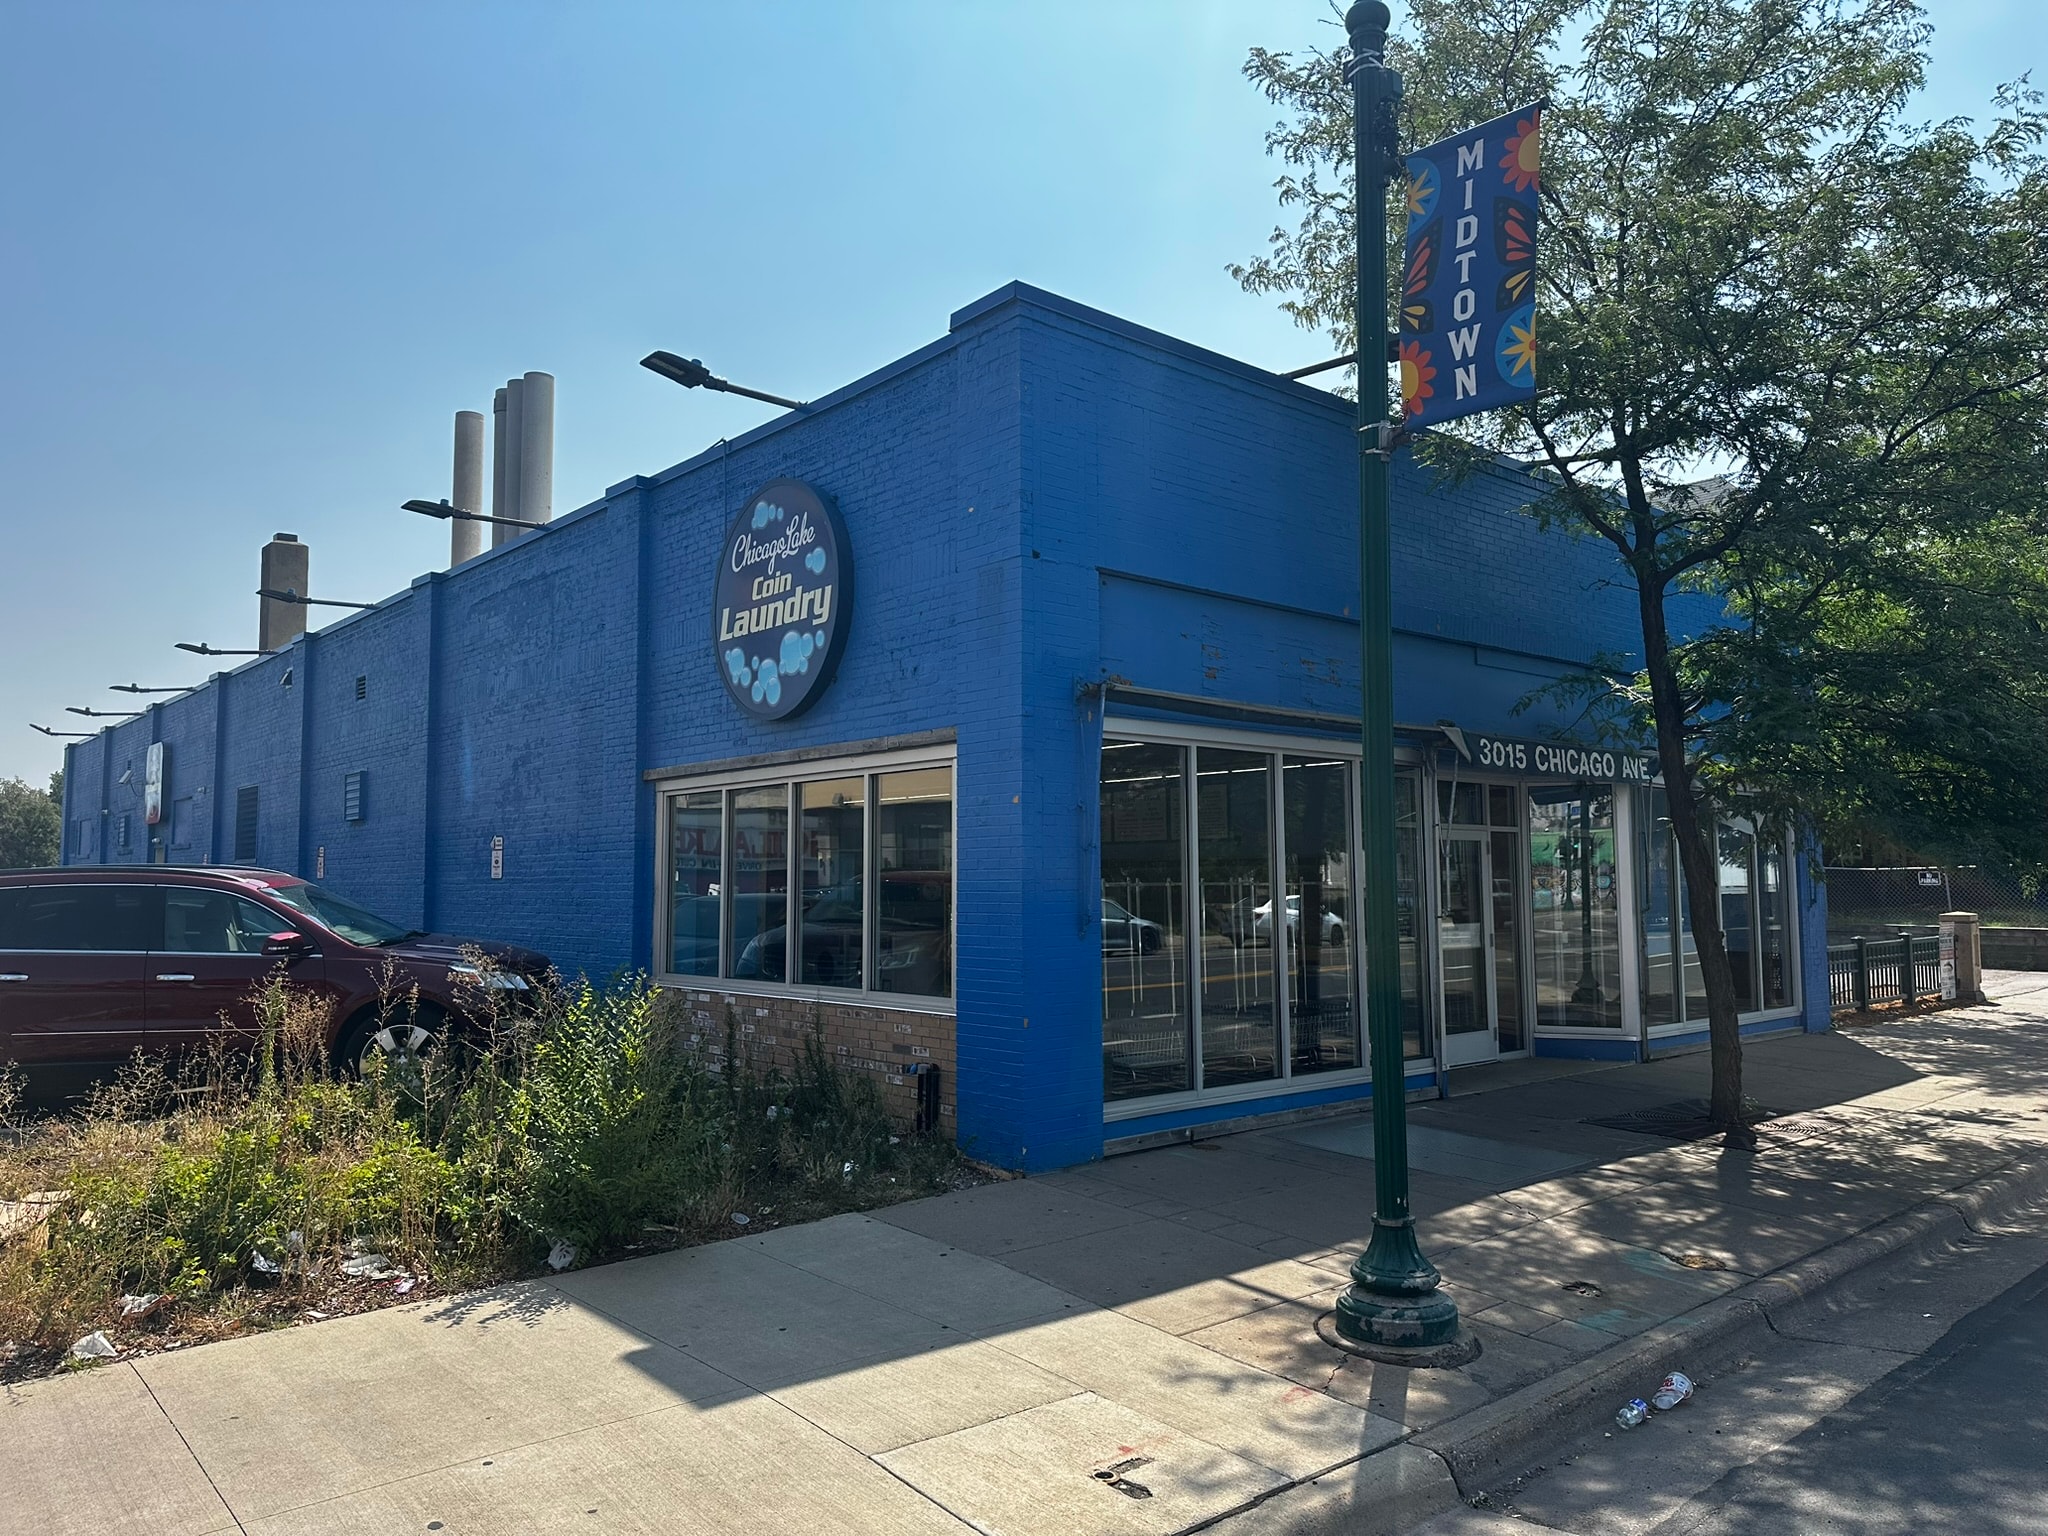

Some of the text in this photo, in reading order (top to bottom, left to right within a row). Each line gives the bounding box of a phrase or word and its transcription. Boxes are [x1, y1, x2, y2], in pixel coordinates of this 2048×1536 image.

[1447, 138, 1485, 401] MIDTOWN
[731, 511, 816, 575] Chicago Lake
[719, 584, 833, 642] Laundry
[752, 570, 793, 602] Coin
[1479, 738, 1527, 769] 3015
[1534, 745, 1616, 778] CHICAGO
